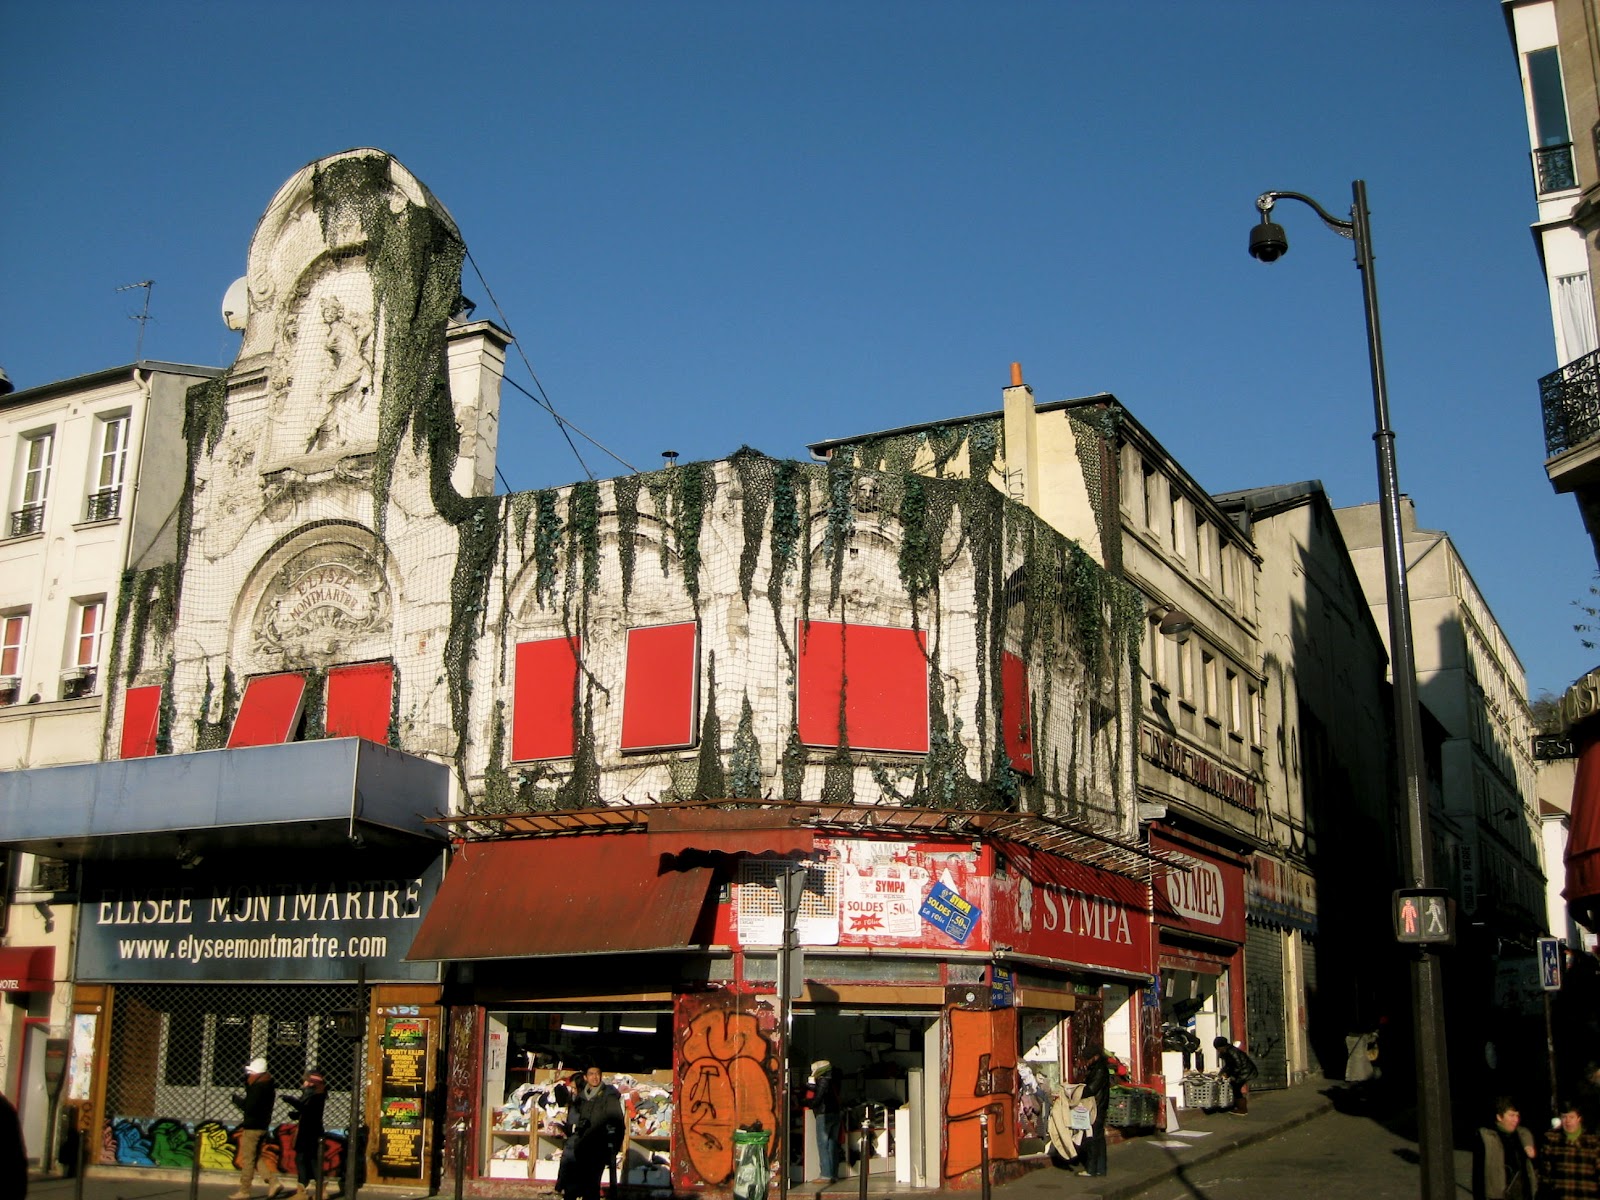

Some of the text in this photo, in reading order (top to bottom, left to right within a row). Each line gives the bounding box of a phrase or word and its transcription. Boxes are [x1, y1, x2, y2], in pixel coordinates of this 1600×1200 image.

[875, 880, 906, 893] SYMPA
[1171, 866, 1222, 918] SYMPA
[97, 879, 423, 925] ELYSEE MONTMARTRE
[847, 900, 884, 912] SOLDES
[926, 896, 952, 917] SOLDES
[949, 894, 972, 914] SYMPA
[1043, 881, 1133, 945] SYMPA
[119, 933, 387, 963] www.elyseemontmartre.com
[390, 1029, 422, 1037] SPLASH
